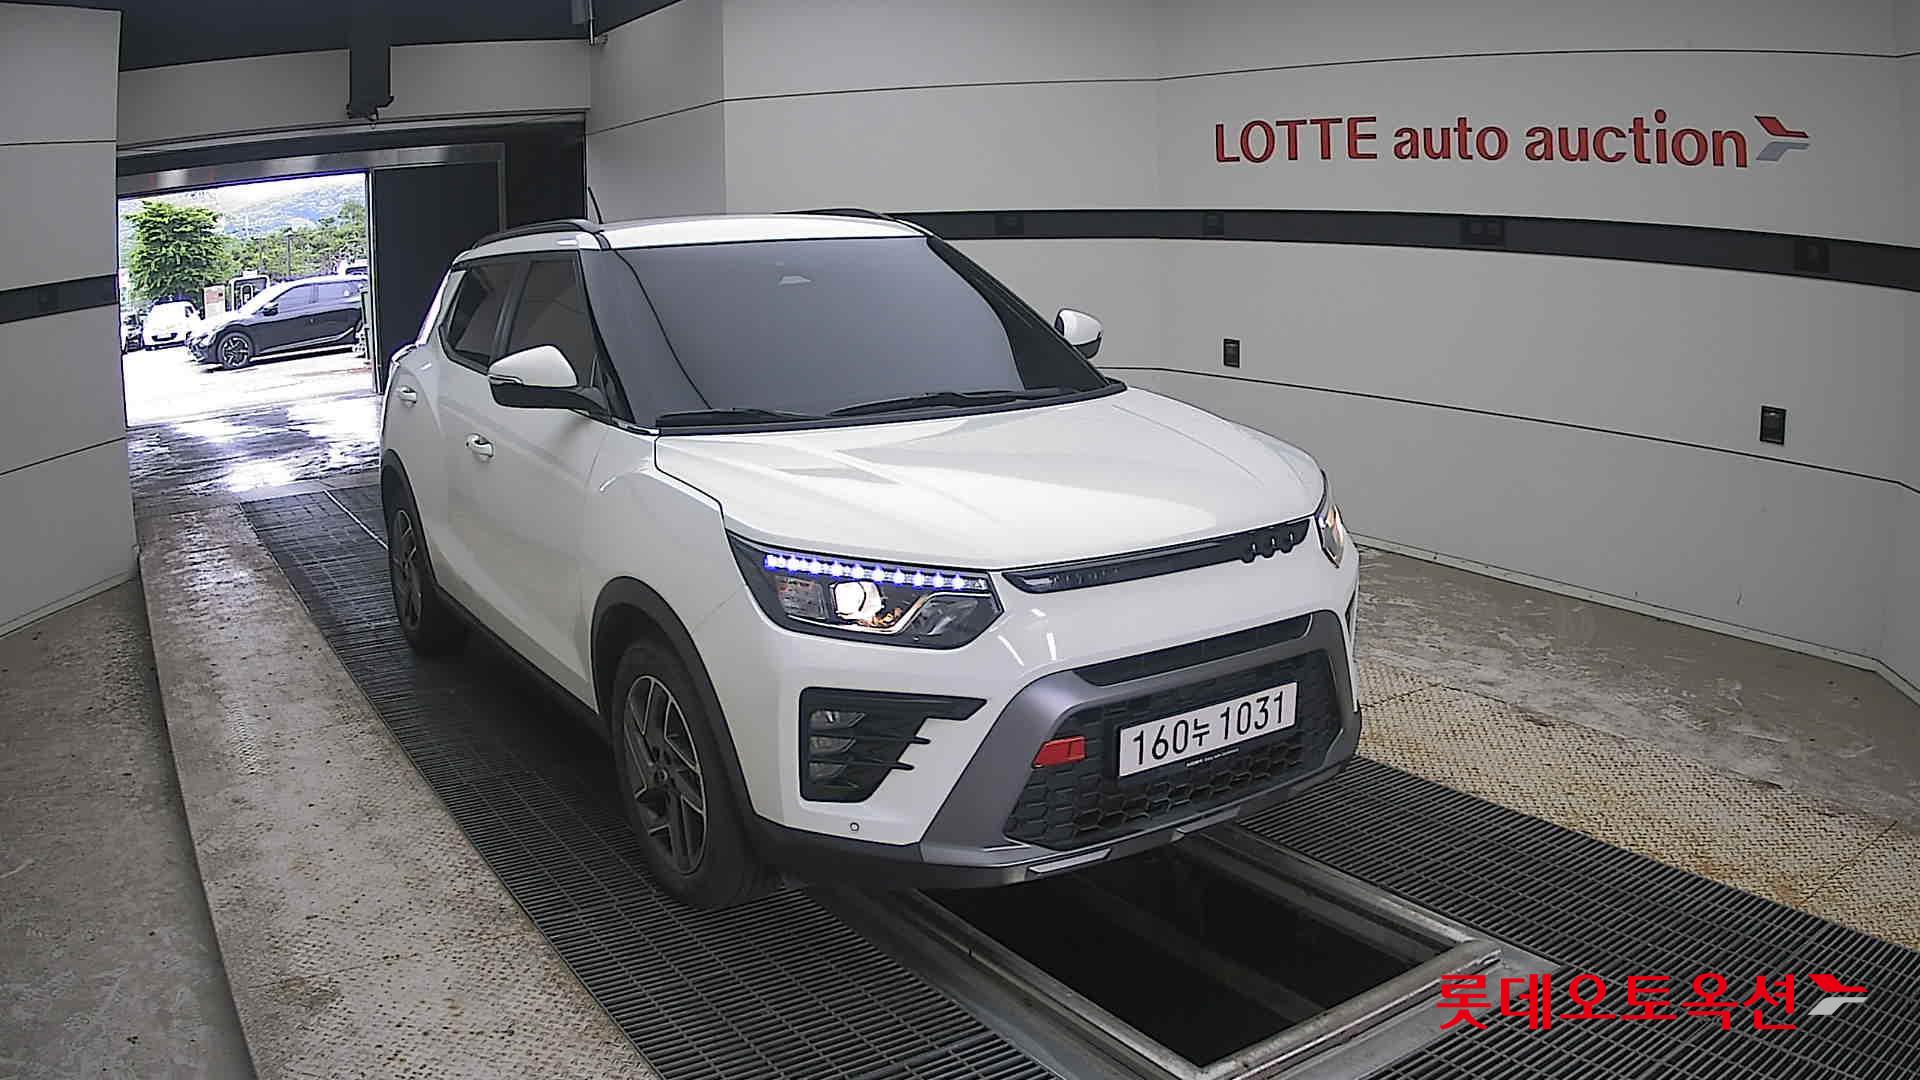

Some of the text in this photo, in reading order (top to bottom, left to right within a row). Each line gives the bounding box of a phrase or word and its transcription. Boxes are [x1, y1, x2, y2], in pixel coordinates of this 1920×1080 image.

[1215, 109, 1748, 168] LOTTE auto auction
[1133, 717, 1210, 766] 160누
[1220, 691, 1284, 740] 1031
